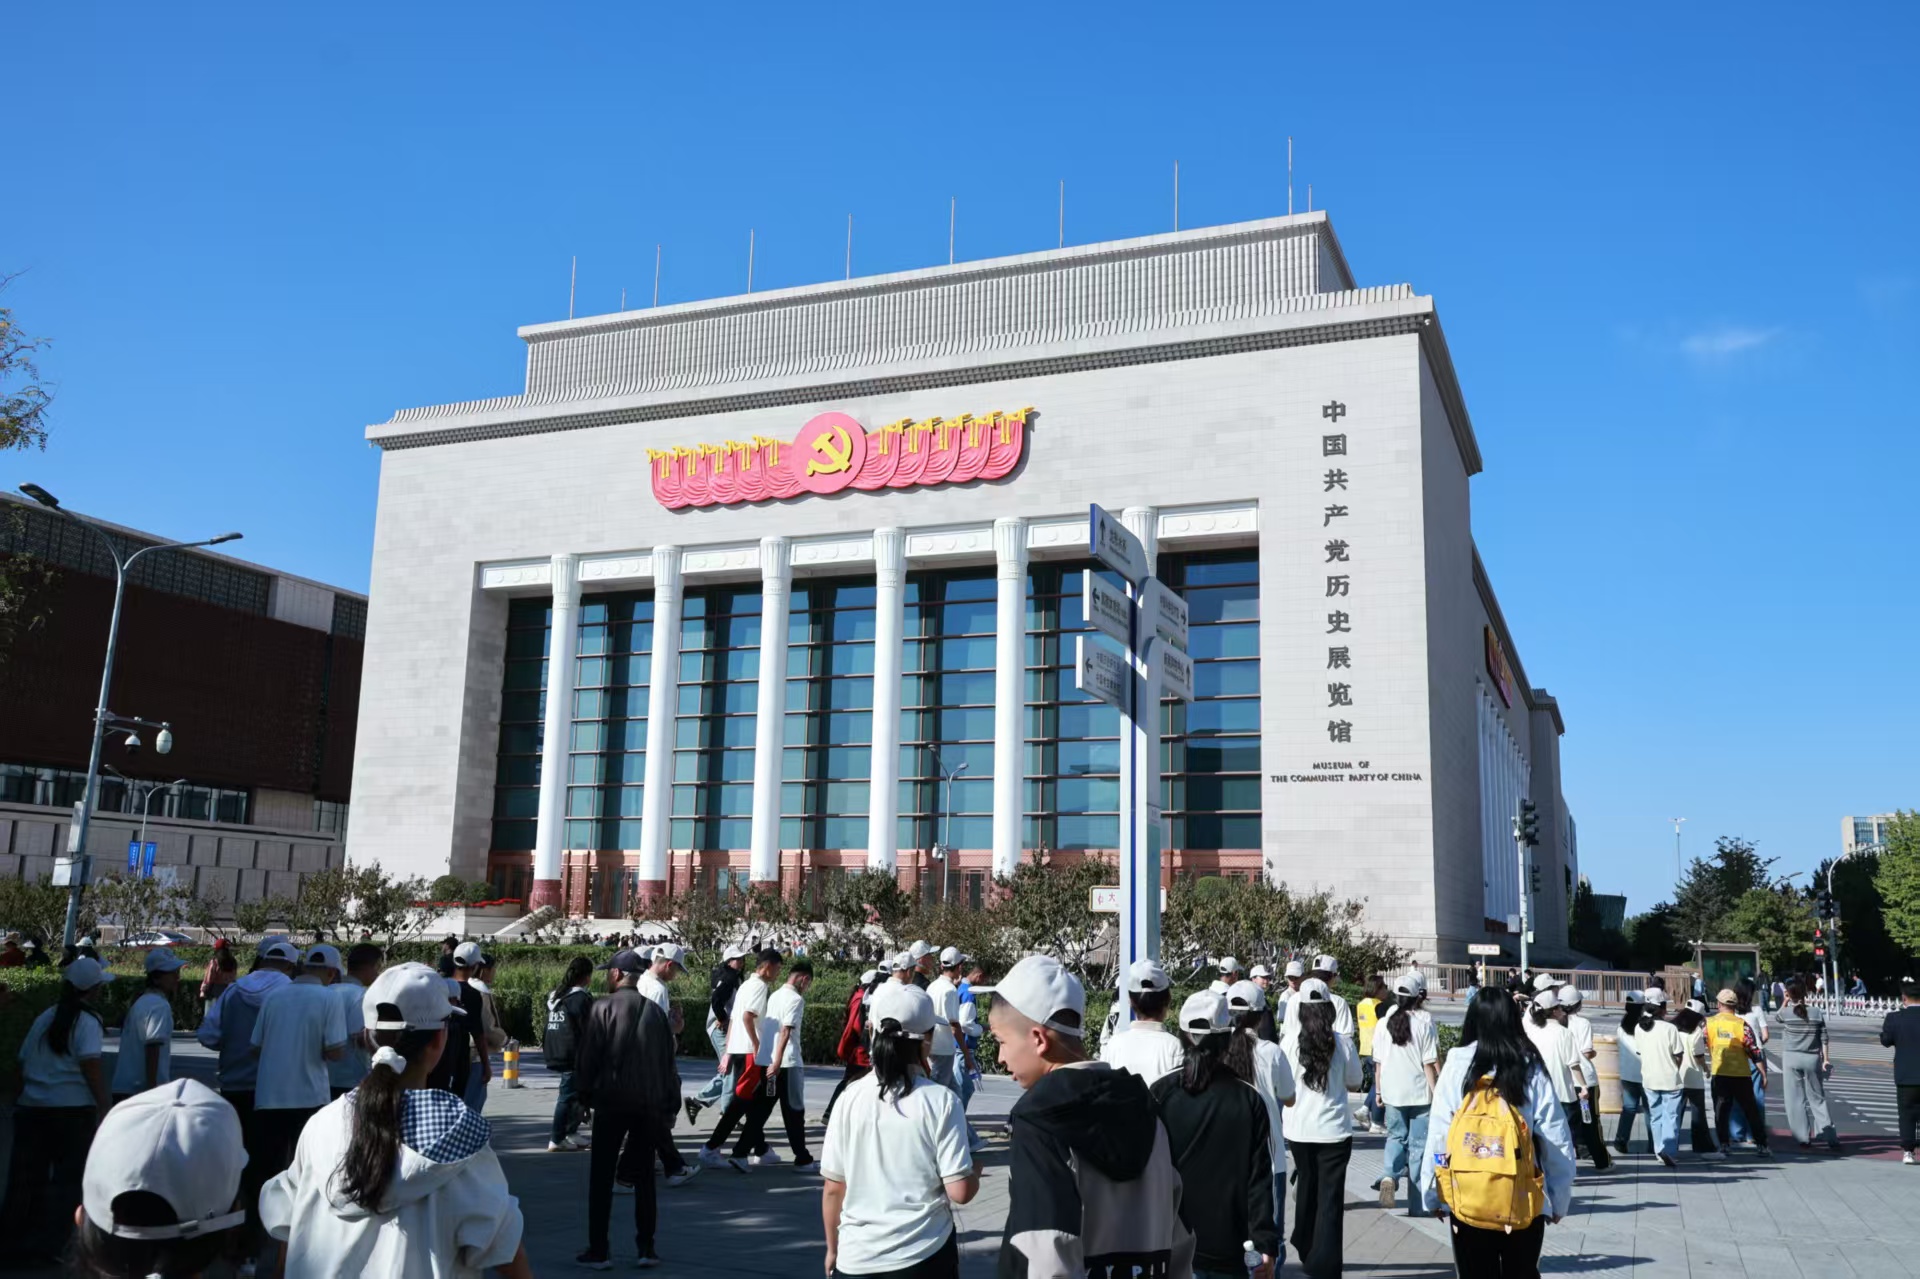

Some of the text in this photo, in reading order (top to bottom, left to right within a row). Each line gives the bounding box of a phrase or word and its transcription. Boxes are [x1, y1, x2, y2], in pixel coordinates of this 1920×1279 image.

[1322, 400, 1353, 743] 中国共产党历史展览馆
[1312, 760, 1370, 770] MUSEUM OF
[1270, 773, 1423, 783] THE COMMUNIST PARTY OF CHINA
